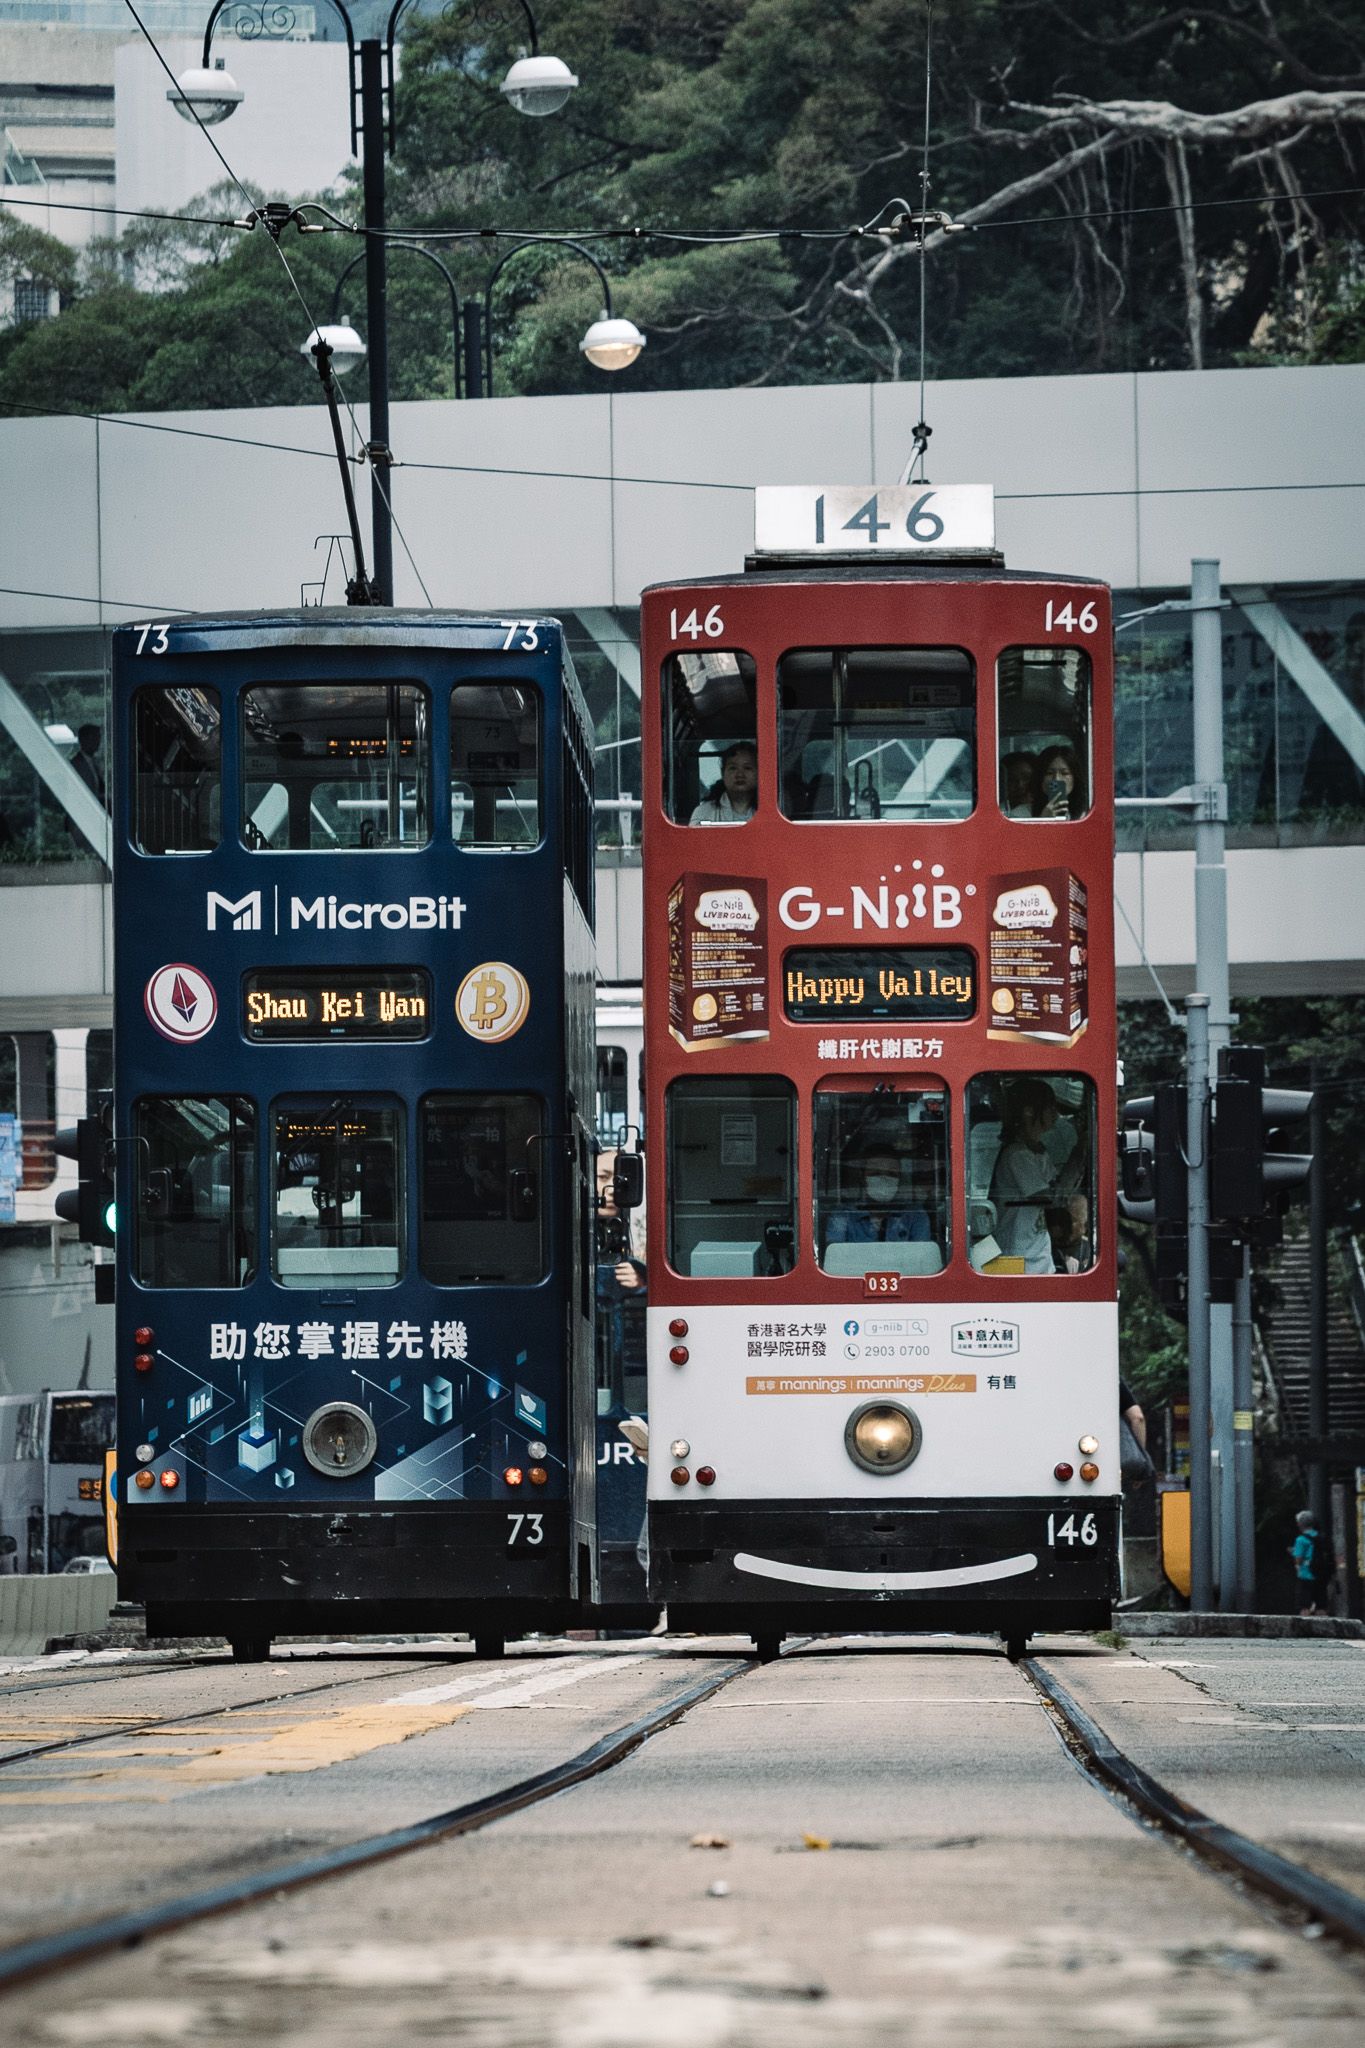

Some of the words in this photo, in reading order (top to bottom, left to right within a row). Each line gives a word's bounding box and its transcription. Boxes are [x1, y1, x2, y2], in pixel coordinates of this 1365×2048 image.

[815, 492, 944, 544] 146
[670, 605, 724, 640] 146
[1045, 600, 1098, 634] 146
[133, 624, 170, 655] 73
[500, 620, 539, 651] 73
[291, 896, 466, 929] MicroBit
[787, 971, 864, 1004] Happy
[879, 969, 972, 1003] Valley
[248, 992, 307, 1022] Shau
[321, 991, 365, 1022] Kei
[380, 991, 425, 1021] Wan
[869, 1277, 898, 1292] 033
[210, 1321, 468, 1360] 助您掌握先機
[747, 1323, 827, 1337] 香港著名大學
[872, 1321, 903, 1334] g-niib
[975, 1329, 1013, 1341] 意大利
[747, 1341, 827, 1357] 醫學院研發
[865, 1346, 895, 1357] 2903
[900, 1345, 930, 1356] 0700
[780, 1378, 847, 1393] mannings
[857, 1377, 924, 1391] mannings
[926, 1374, 966, 1397] Plus
[987, 1375, 1016, 1389] 有售
[507, 1513, 544, 1545] 73
[1047, 1513, 1098, 1546] 146
